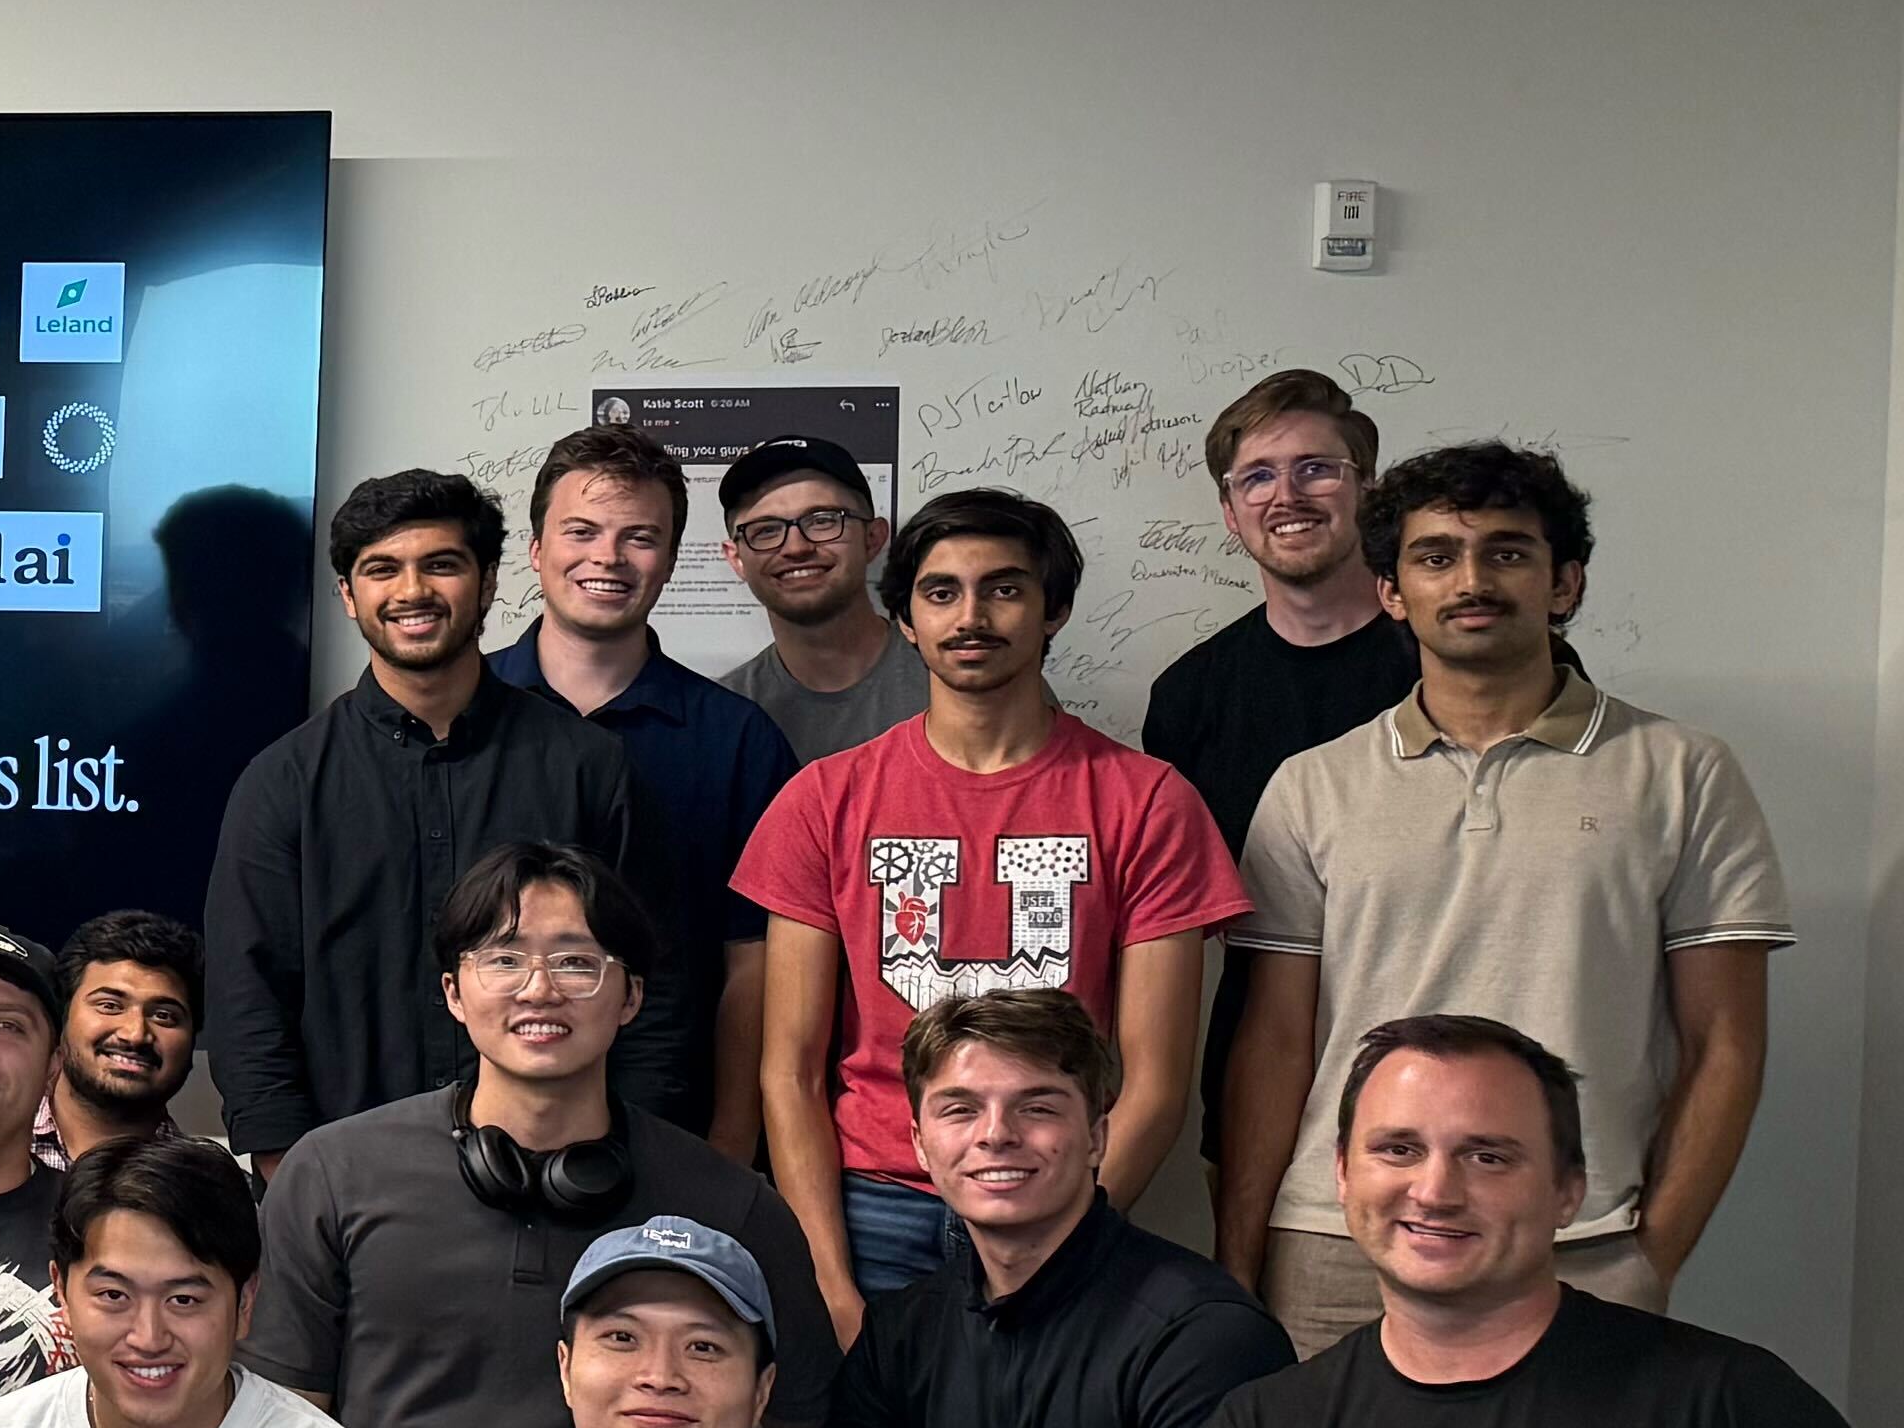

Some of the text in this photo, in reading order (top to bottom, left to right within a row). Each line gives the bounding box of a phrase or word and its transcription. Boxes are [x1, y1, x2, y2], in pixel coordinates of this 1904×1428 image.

[35, 315, 113, 334] Leland
[674, 398, 704, 410] Scott
[692, 446, 715, 459] you
[32, 735, 139, 813] list.
[1028, 910, 1063, 925] 2020
